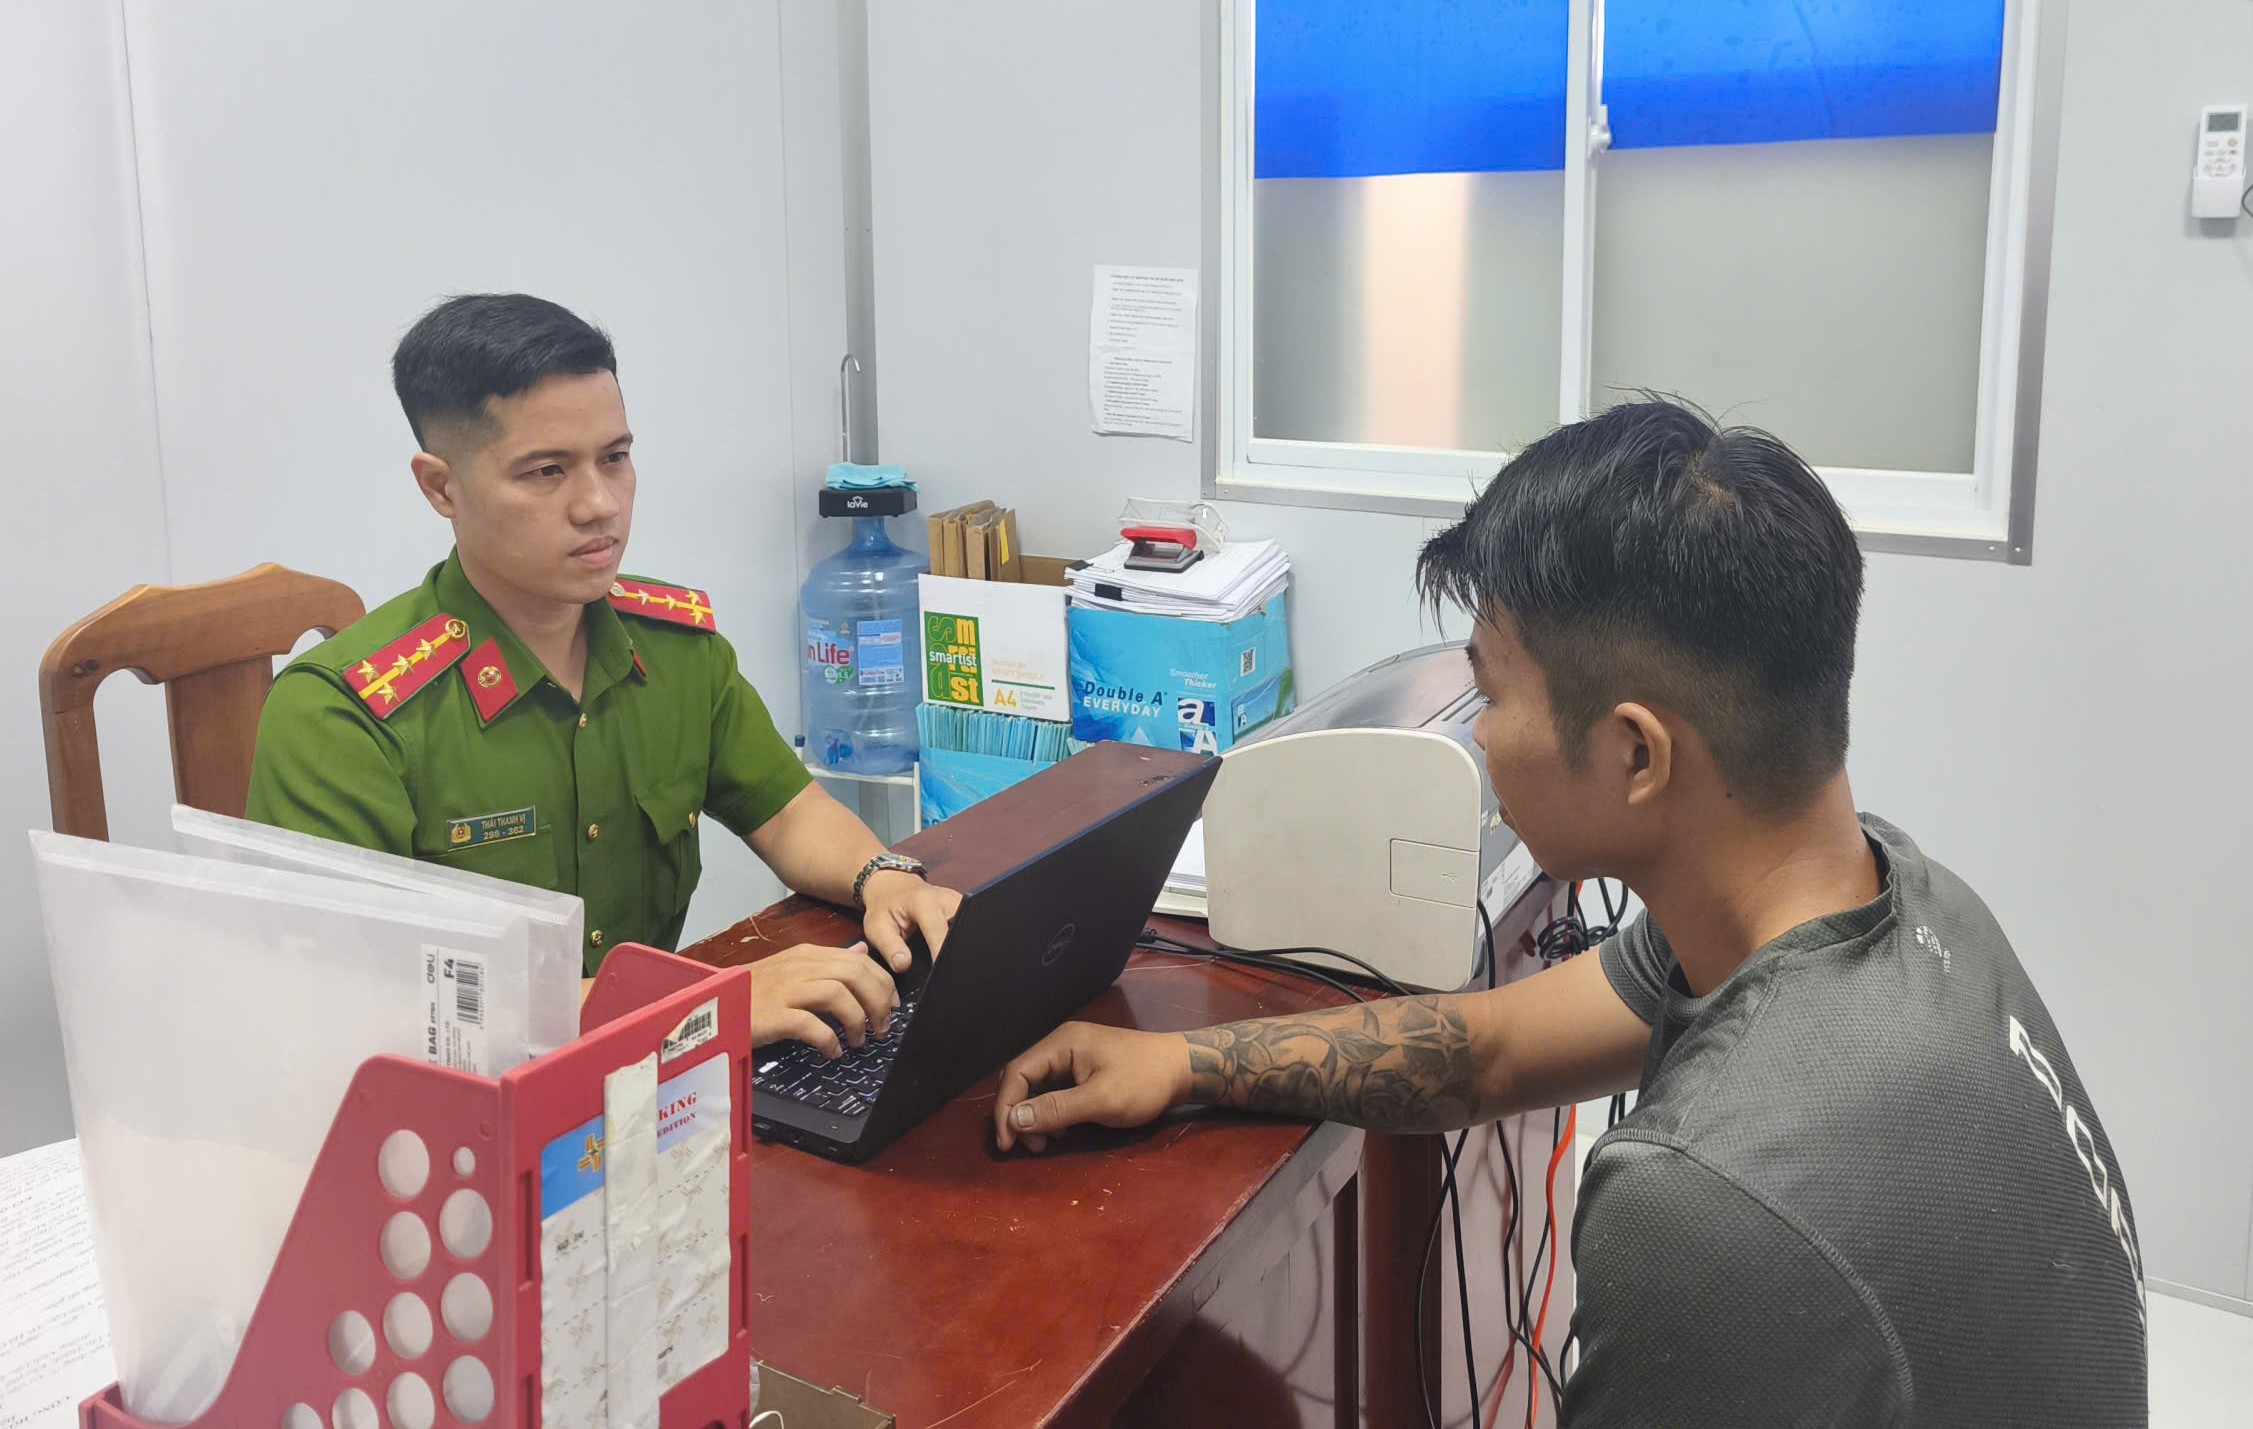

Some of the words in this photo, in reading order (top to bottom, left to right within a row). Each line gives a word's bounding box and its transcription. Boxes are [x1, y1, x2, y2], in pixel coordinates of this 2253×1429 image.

[929, 650, 978, 667] smartist
[994, 688, 1017, 708] A4
[1084, 681, 1144, 703] Double
[1151, 691, 1164, 706] A
[1083, 696, 1162, 718] EVERYDAY
[426, 953, 436, 984] deli
[443, 958, 455, 979] F4
[427, 1026, 438, 1055] BAG
[657, 1092, 697, 1122] KING
[656, 1111, 696, 1139] EDITION
